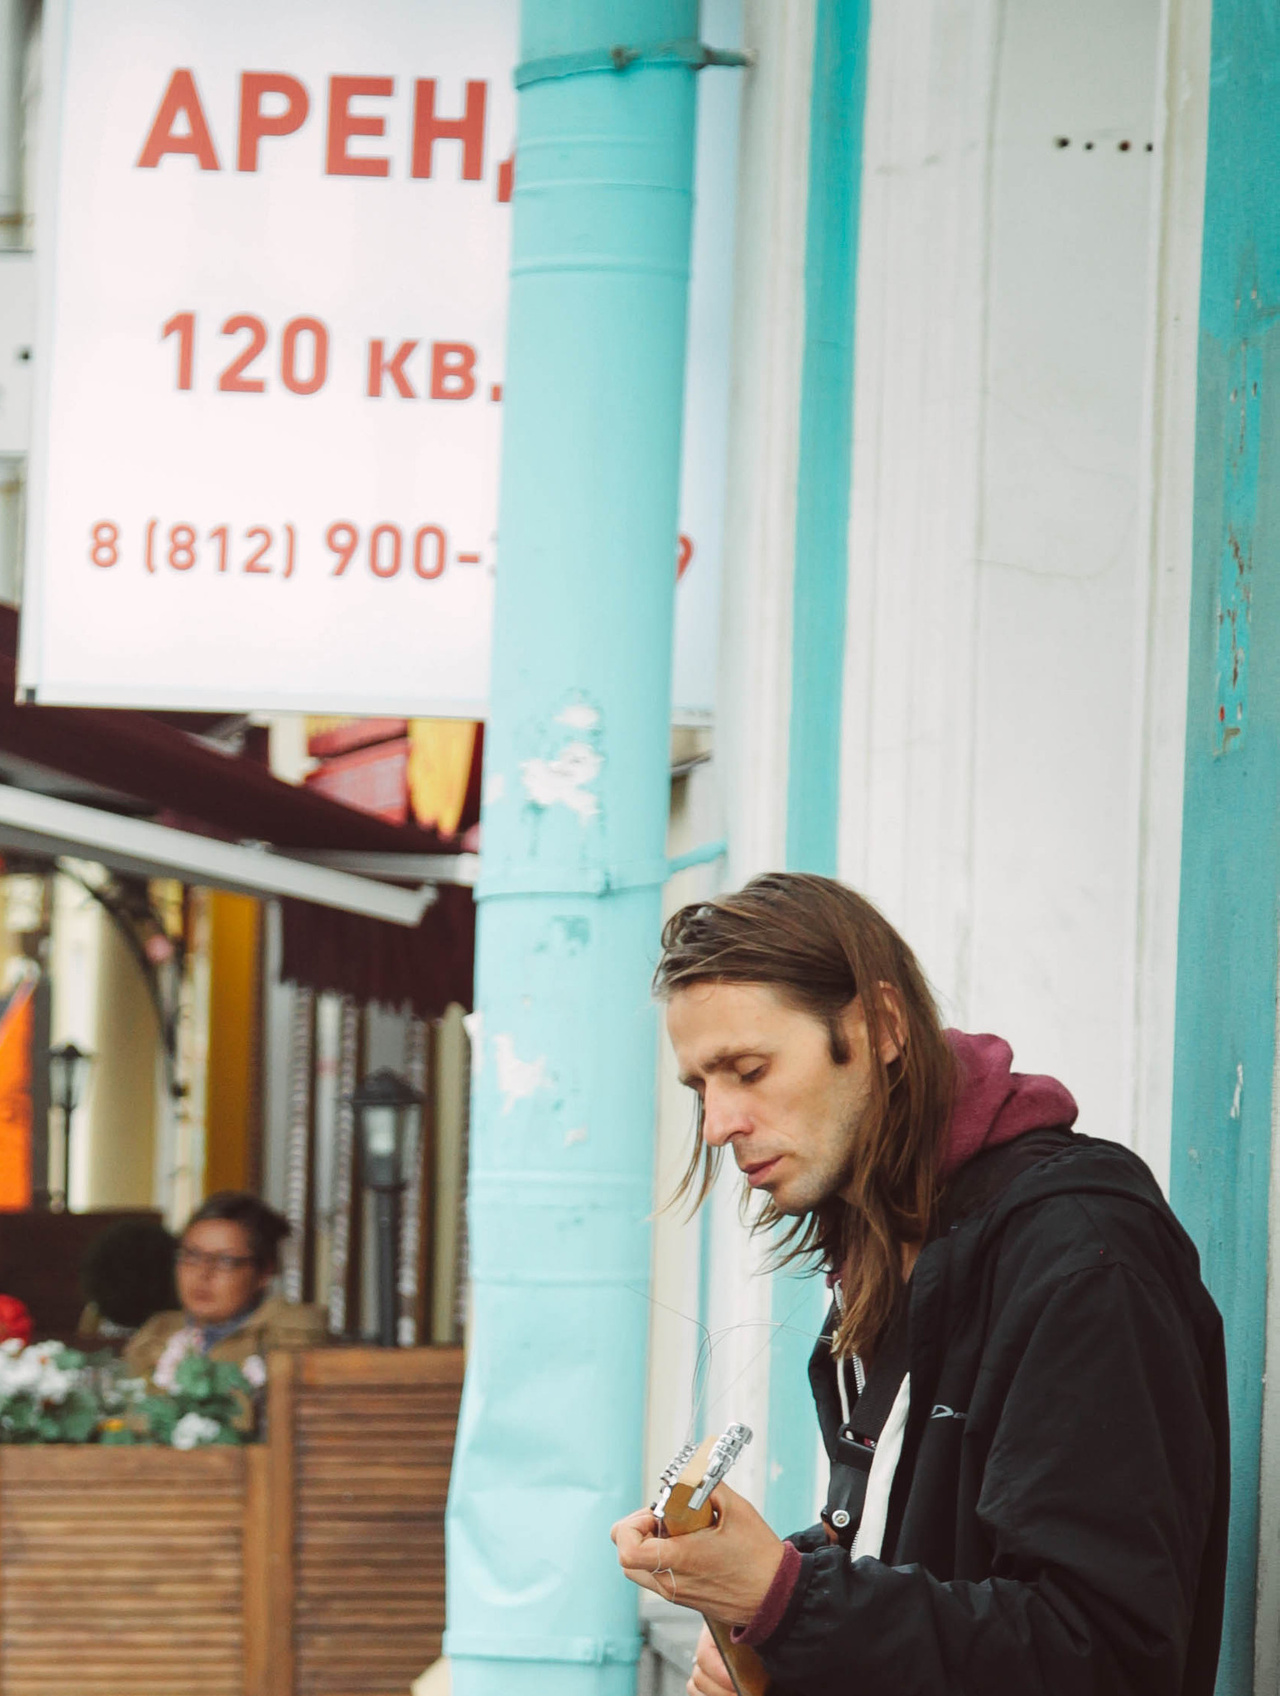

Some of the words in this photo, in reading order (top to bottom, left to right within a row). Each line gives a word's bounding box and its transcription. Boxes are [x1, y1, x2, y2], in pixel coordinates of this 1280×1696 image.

[136, 66, 514, 203] АРЕН
[161, 309, 330, 396] 120
[366, 337, 503, 403] кв.
[90, 520, 119, 570] 8
[145, 518, 297, 579] (812)
[326, 521, 496, 581] 900-
